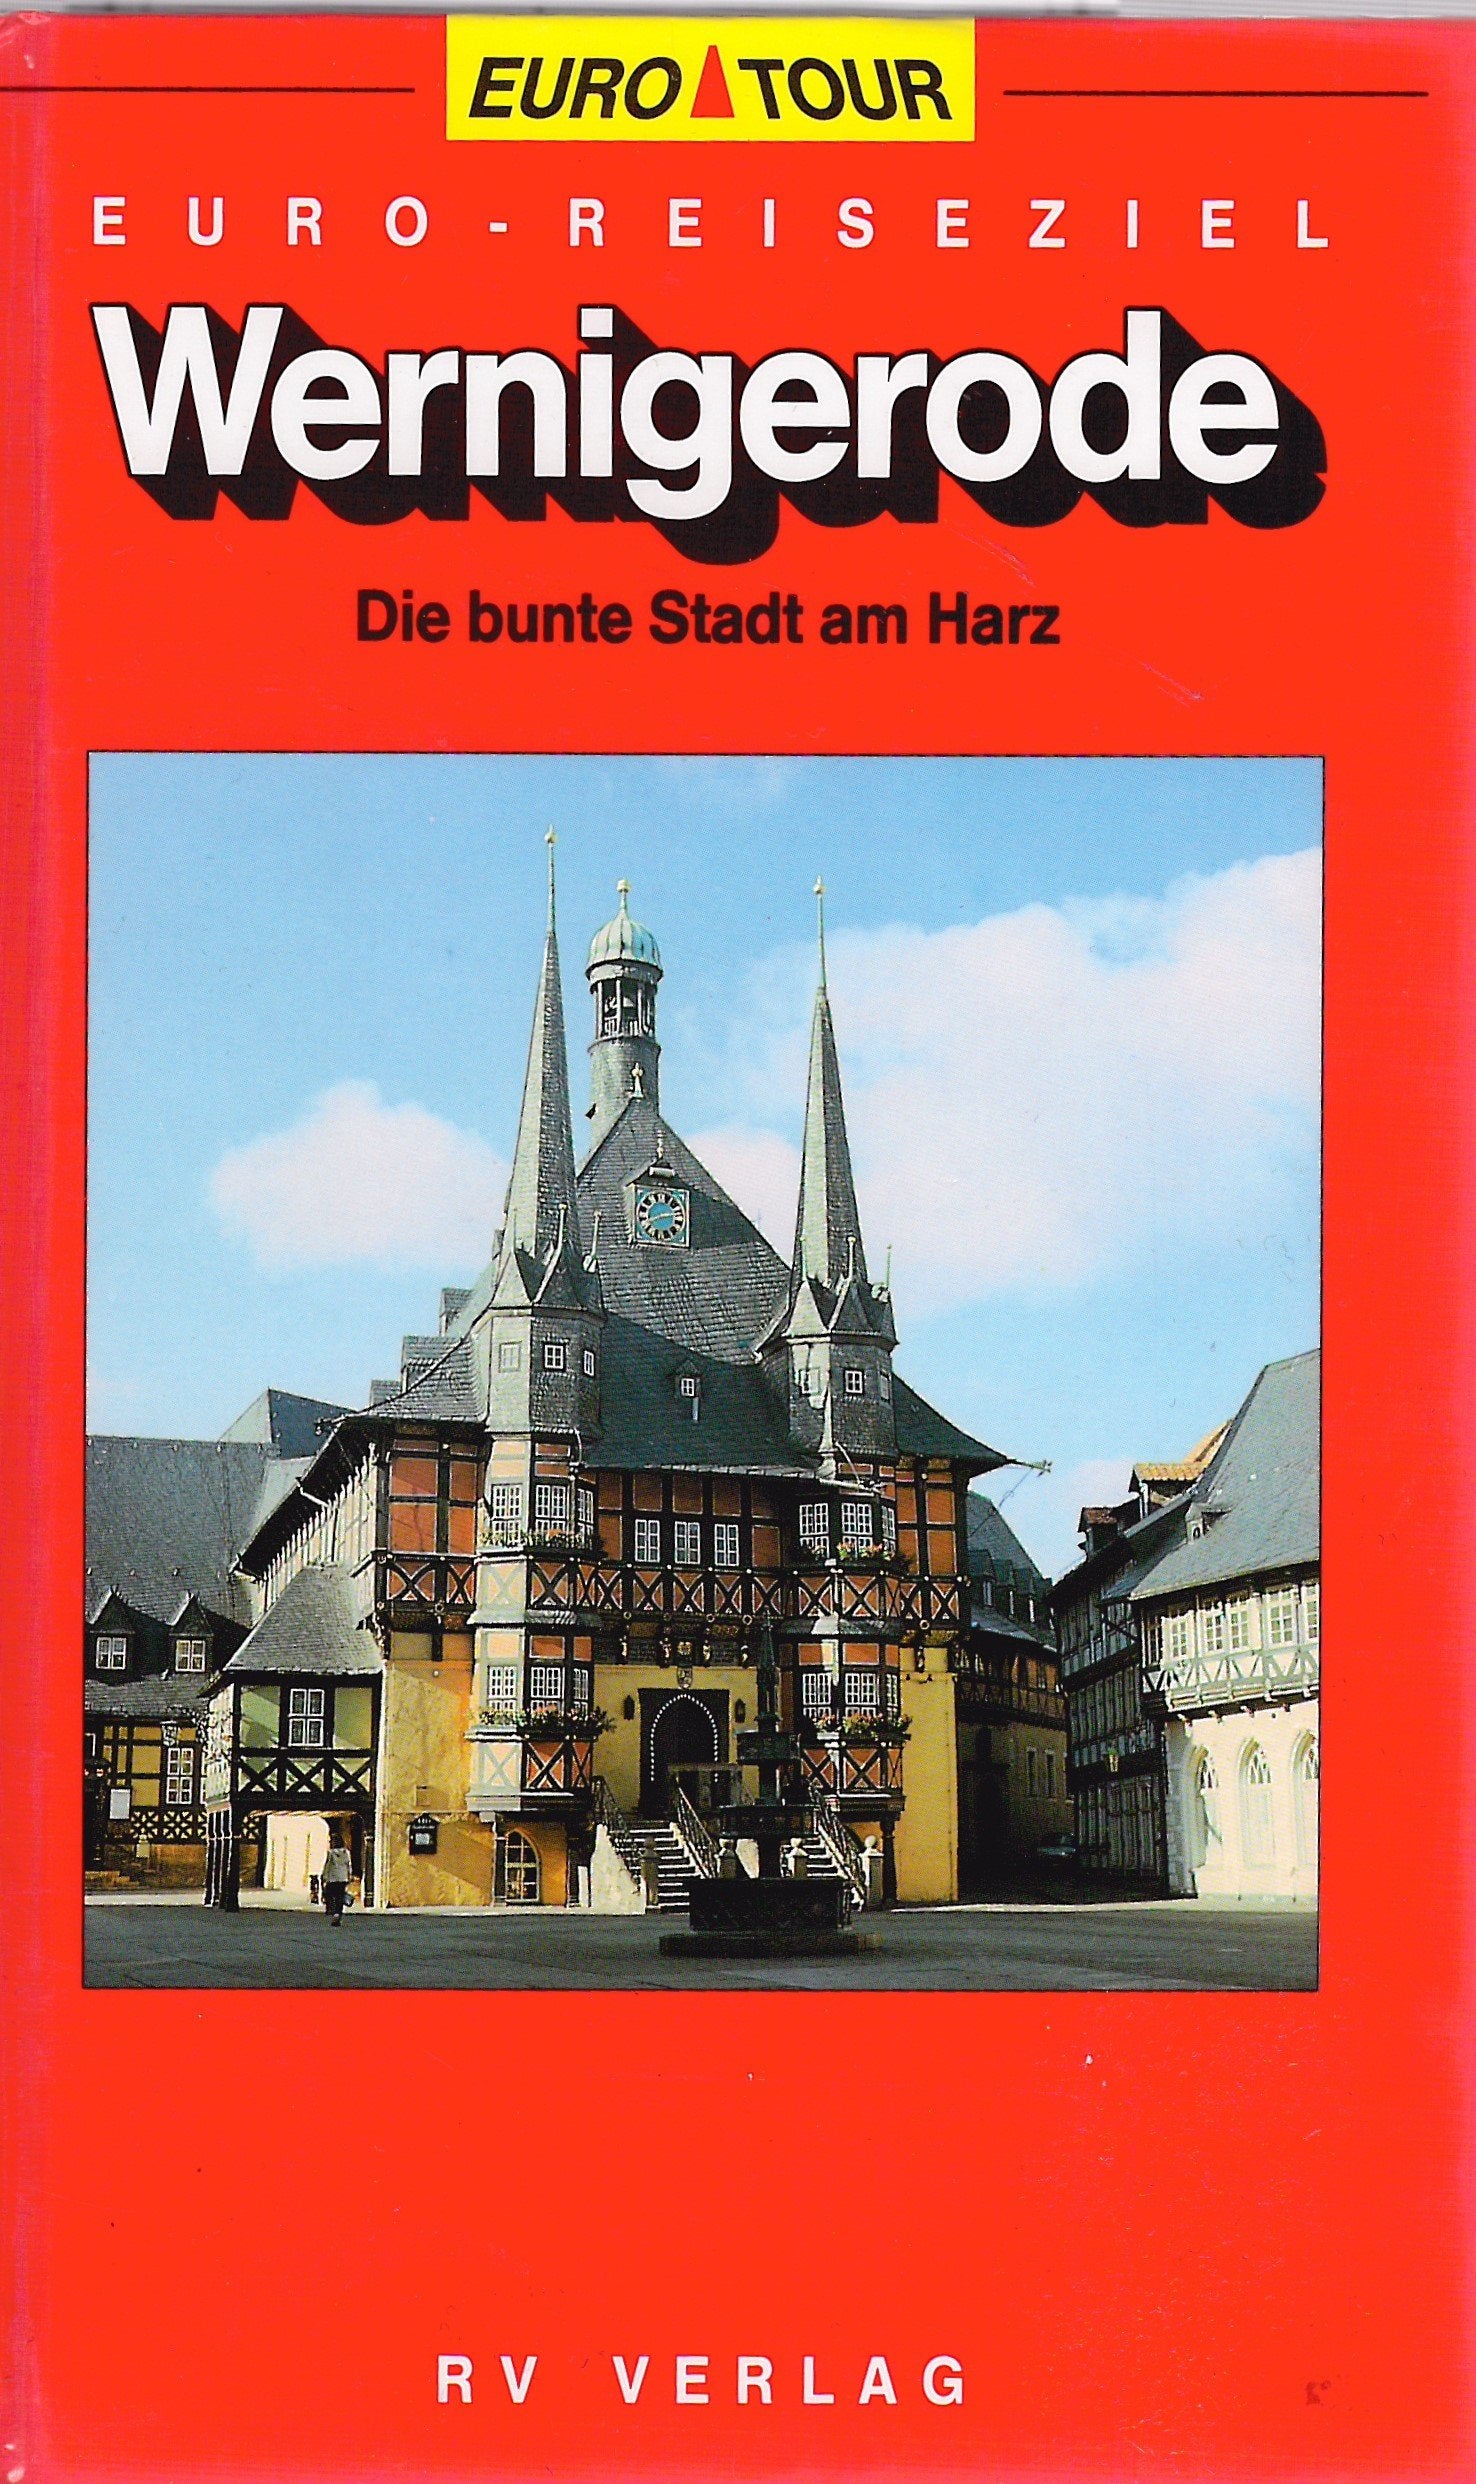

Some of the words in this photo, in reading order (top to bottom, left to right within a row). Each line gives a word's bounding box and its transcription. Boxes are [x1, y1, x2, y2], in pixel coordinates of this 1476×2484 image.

[469, 57, 683, 119] EURO
[738, 58, 953, 120] TOUR
[93, 196, 1329, 248] EURO-REISEZIEL
[92, 305, 1281, 521] Wernigerode
[357, 589, 451, 643] Die
[469, 589, 633, 644] bunte
[649, 589, 804, 645] Stadt
[820, 603, 908, 645] am
[929, 591, 1061, 646] Harz
[438, 2355, 538, 2404] RV
[612, 2355, 963, 2406] VERLAG
